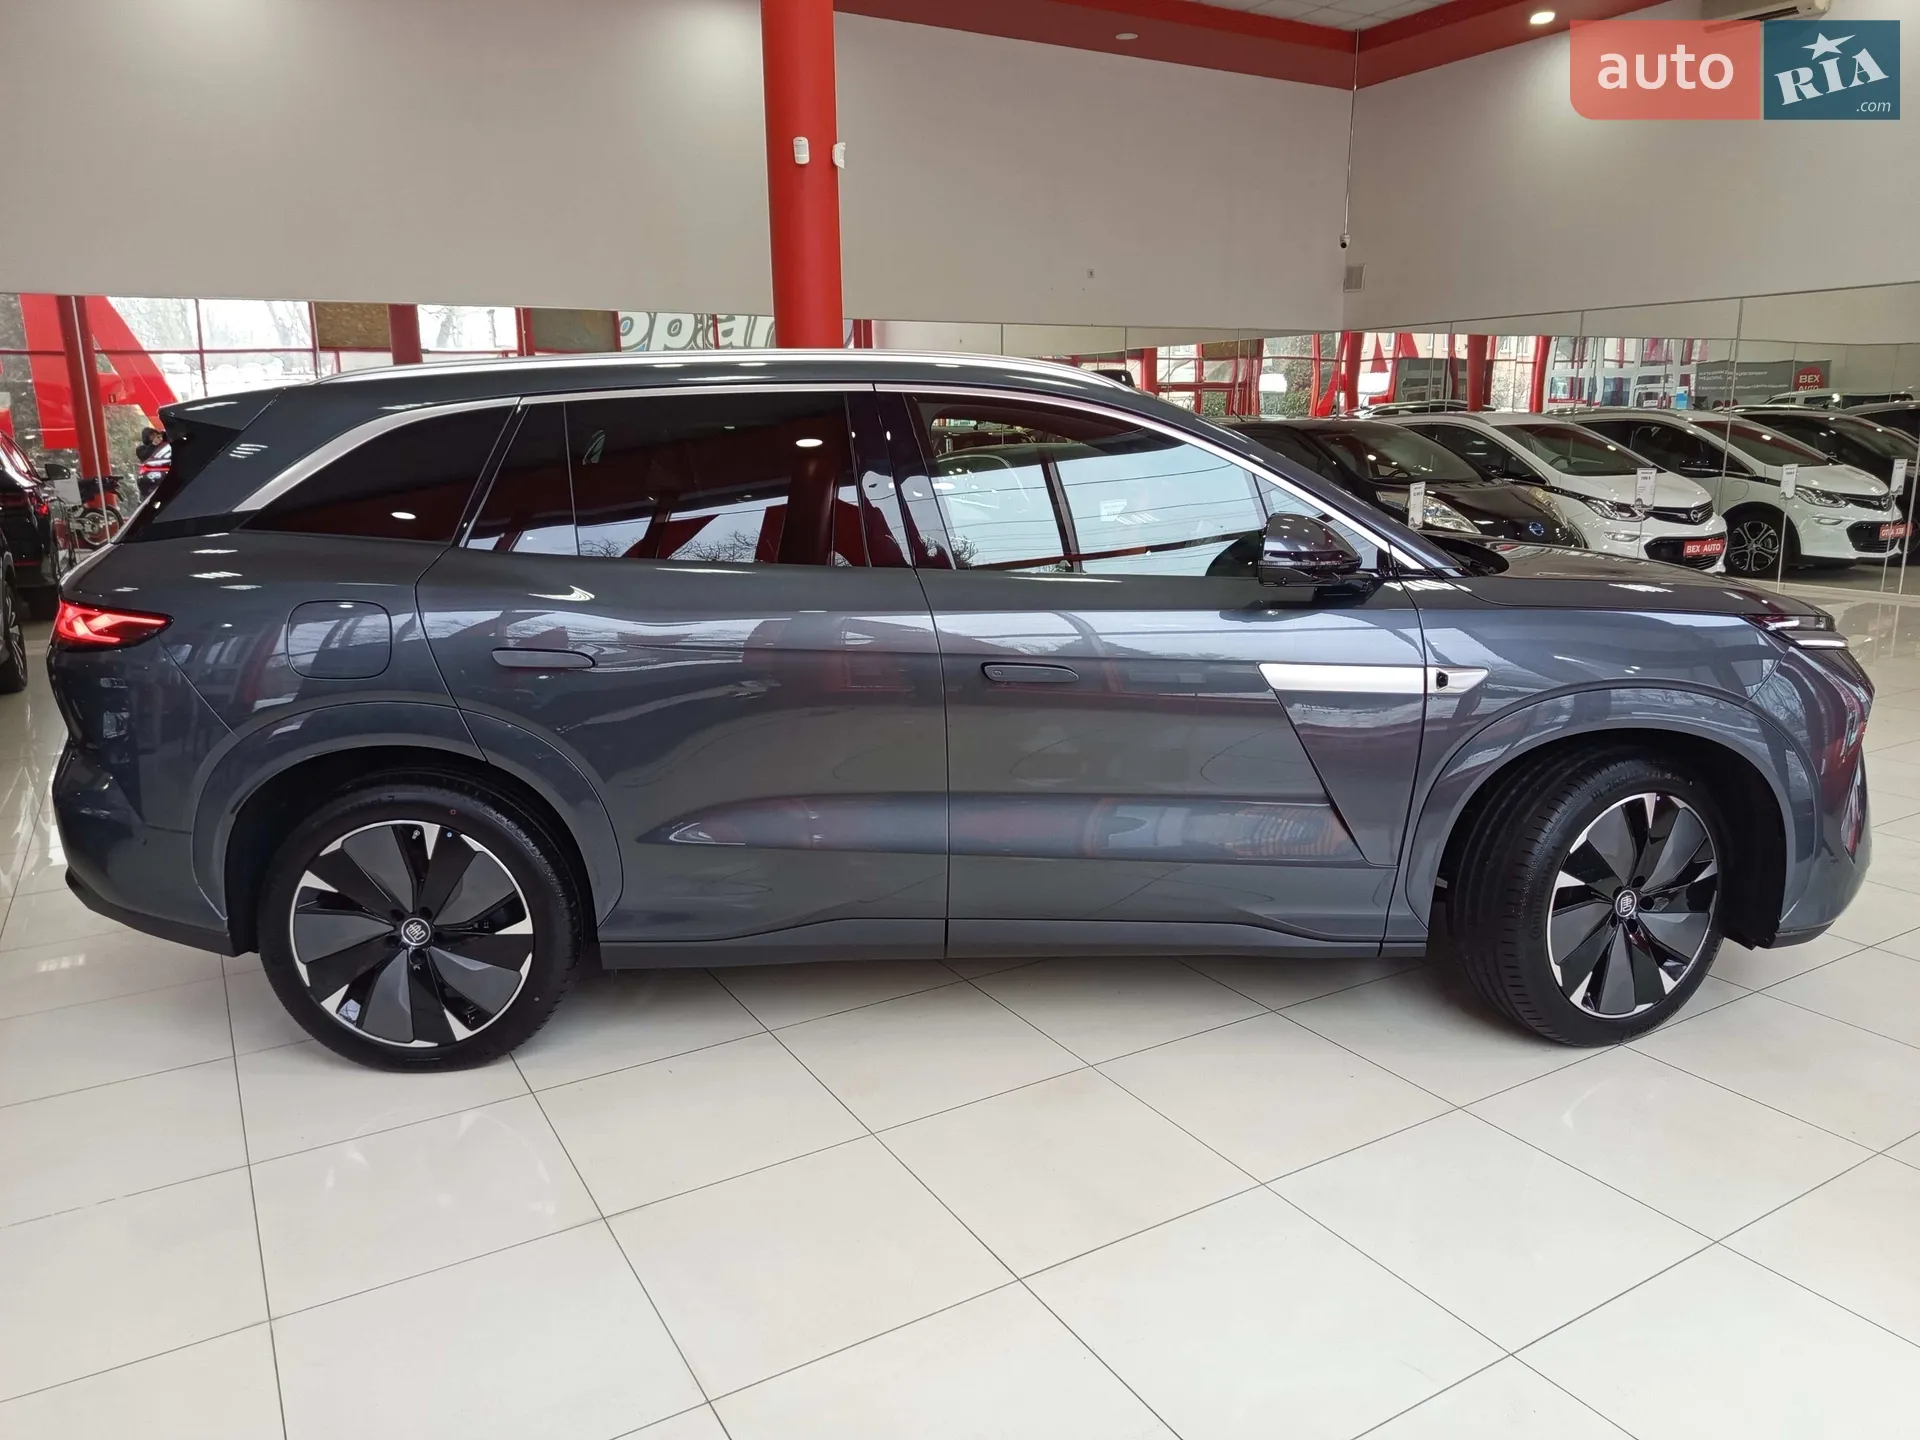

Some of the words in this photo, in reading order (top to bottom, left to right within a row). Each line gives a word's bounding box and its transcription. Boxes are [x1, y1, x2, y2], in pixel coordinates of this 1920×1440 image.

[1799, 374, 1820, 383] BEX
[1686, 545, 1701, 553] BEX
[1703, 543, 1721, 552] AUTO
